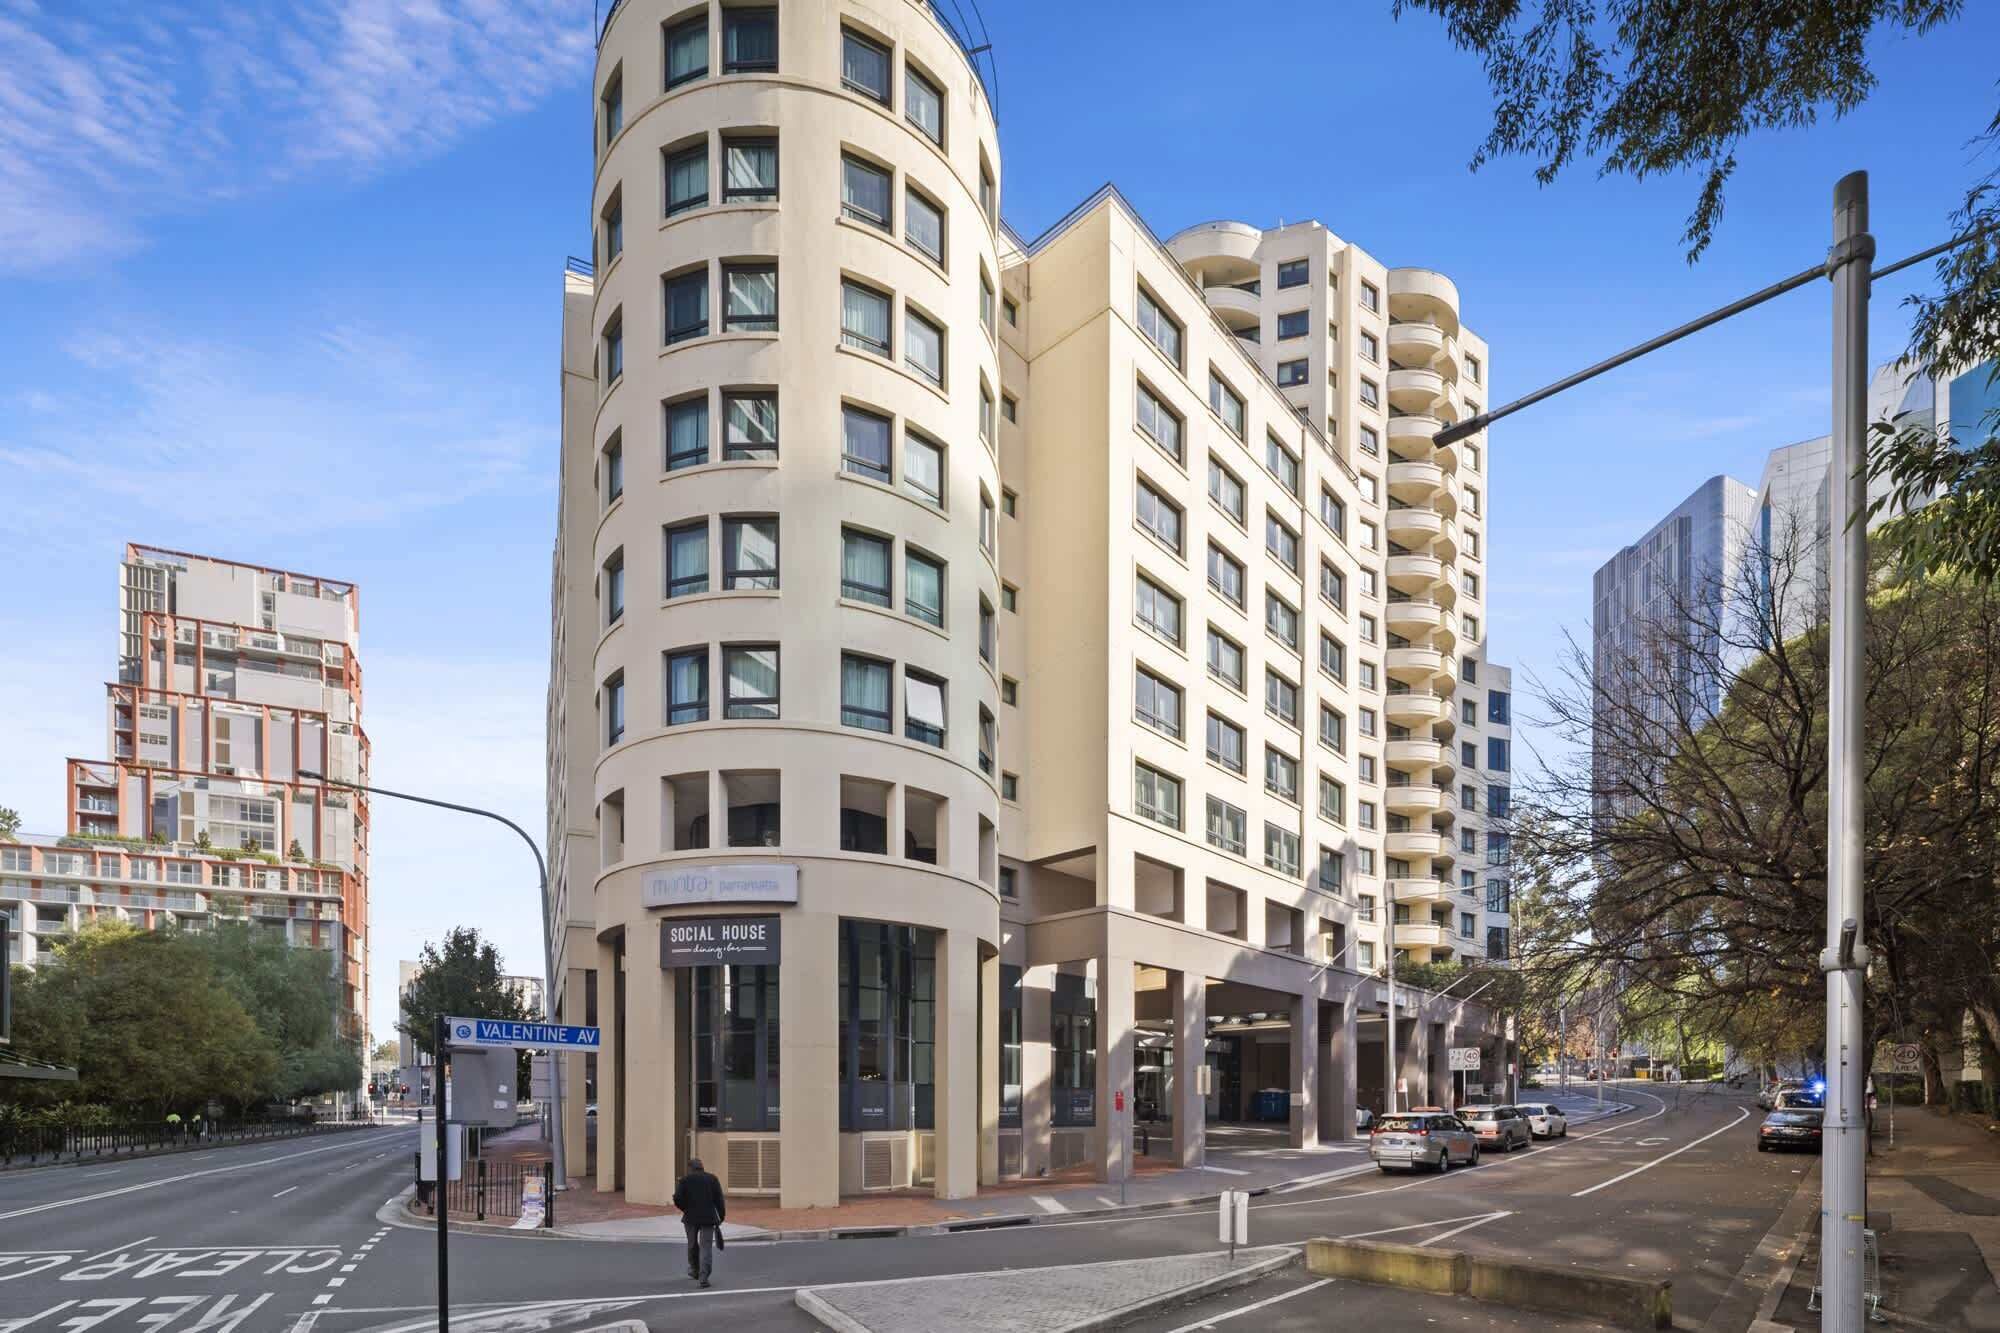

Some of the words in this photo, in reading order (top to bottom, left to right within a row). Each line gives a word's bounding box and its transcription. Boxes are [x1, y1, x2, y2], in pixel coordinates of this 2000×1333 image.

[671, 925, 715, 943] SOCIAL
[722, 925, 766, 941] HOUSE
[481, 1022, 568, 1042] VALENTINE
[576, 1029, 596, 1044] AV
[60, 1249, 343, 1280] CLEAR
